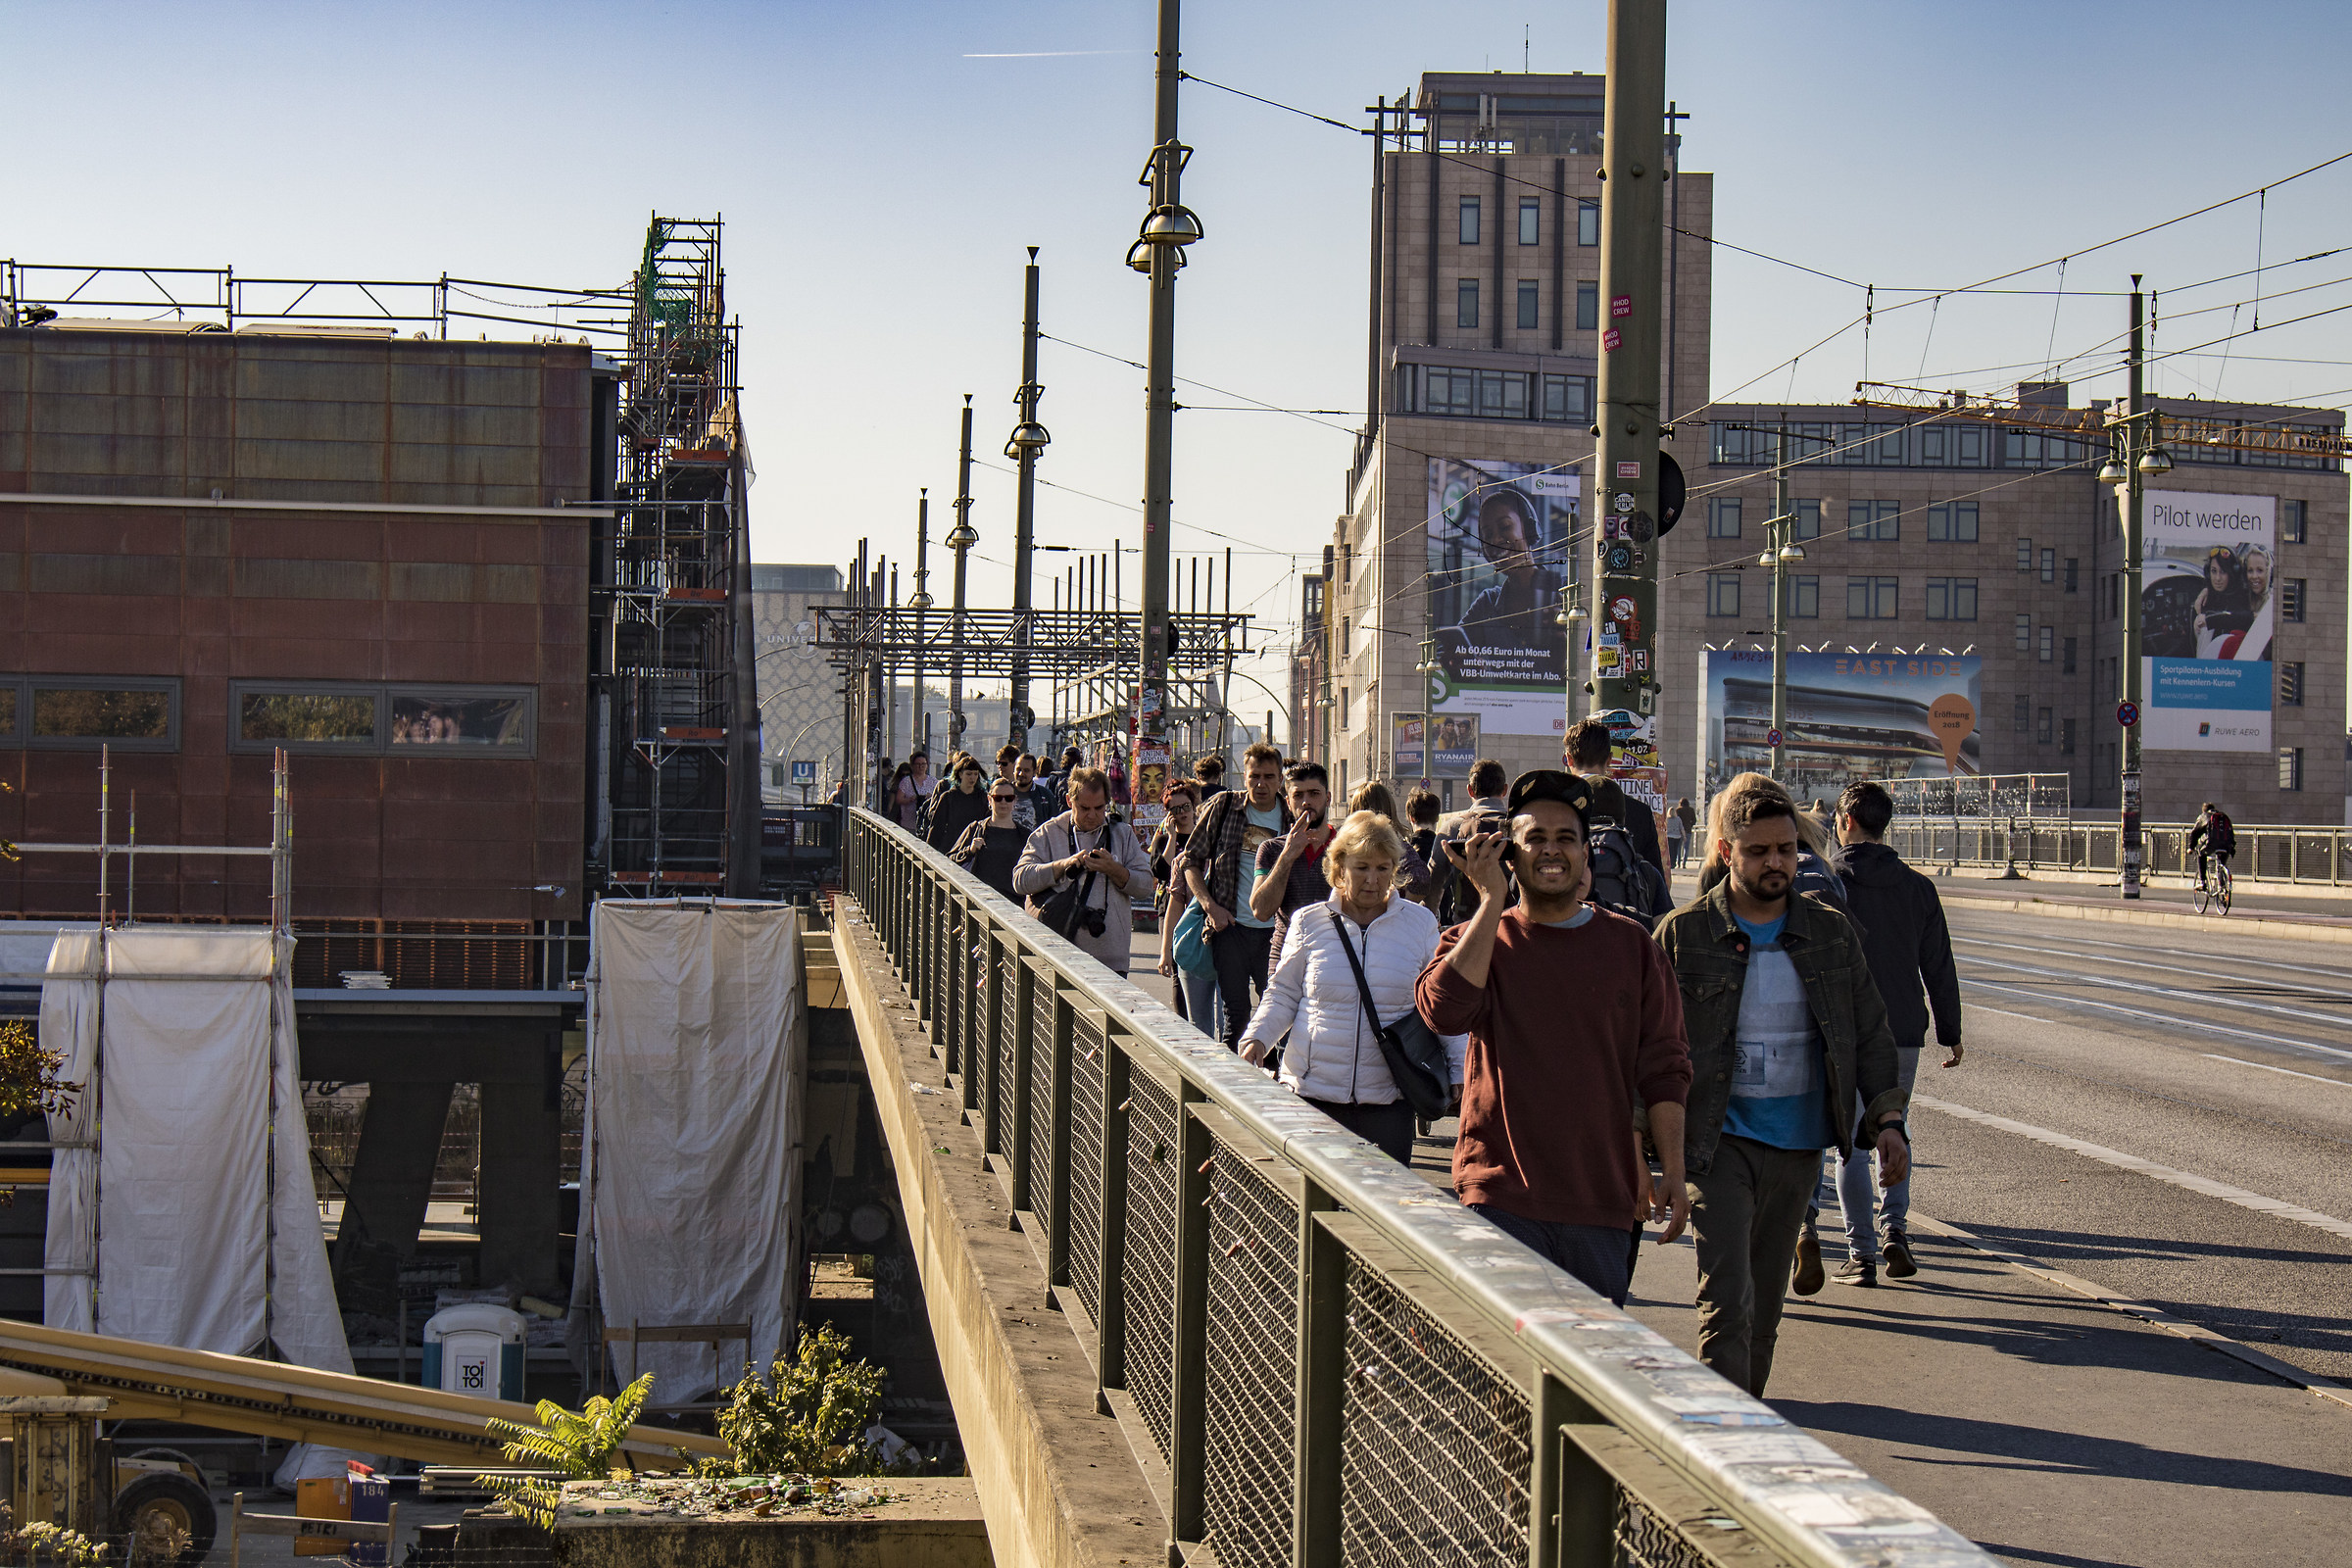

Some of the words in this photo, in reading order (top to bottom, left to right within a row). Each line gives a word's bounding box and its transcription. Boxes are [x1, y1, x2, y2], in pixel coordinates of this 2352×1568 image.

[1613, 298, 1629, 307] #HOD
[1613, 307, 1629, 315] CREW
[1605, 331, 1618, 341] #HOD
[1605, 339, 1619, 349] CREW
[2153, 504, 2191, 527] Pilot
[2196, 508, 2262, 531] werden
[767, 635, 835, 643] UNIVERSA
[1455, 645, 1467, 654] Ab
[1468, 646, 1492, 655] 60,66
[1494, 647, 1513, 656] Euro
[1514, 648, 1524, 656] im
[1525, 648, 1551, 657] Monat
[1599, 652, 1616, 663] TAVAR
[1463, 659, 1505, 669] unterwegs
[1521, 660, 1535, 668] der
[1836, 659, 1897, 675] EAST
[1907, 661, 1962, 677] SIDE
[1460, 668, 1531, 679] VBB-Umweltkarte
[1532, 671, 1542, 679] im
[1543, 671, 1562, 681] Abo.
[2160, 665, 2242, 678] Sportpiloten-Ausbildung
[2173, 677, 2236, 687] Kennenlern-Kursen
[1934, 710, 1970, 720] Eröffnung
[2239, 728, 2260, 736] AERO
[798, 763, 808, 777] U
[463, 1363, 485, 1376] TOI
[462, 1377, 484, 1388] TOI
[362, 1485, 384, 1497] 184
[300, 1522, 338, 1536] PETRI
